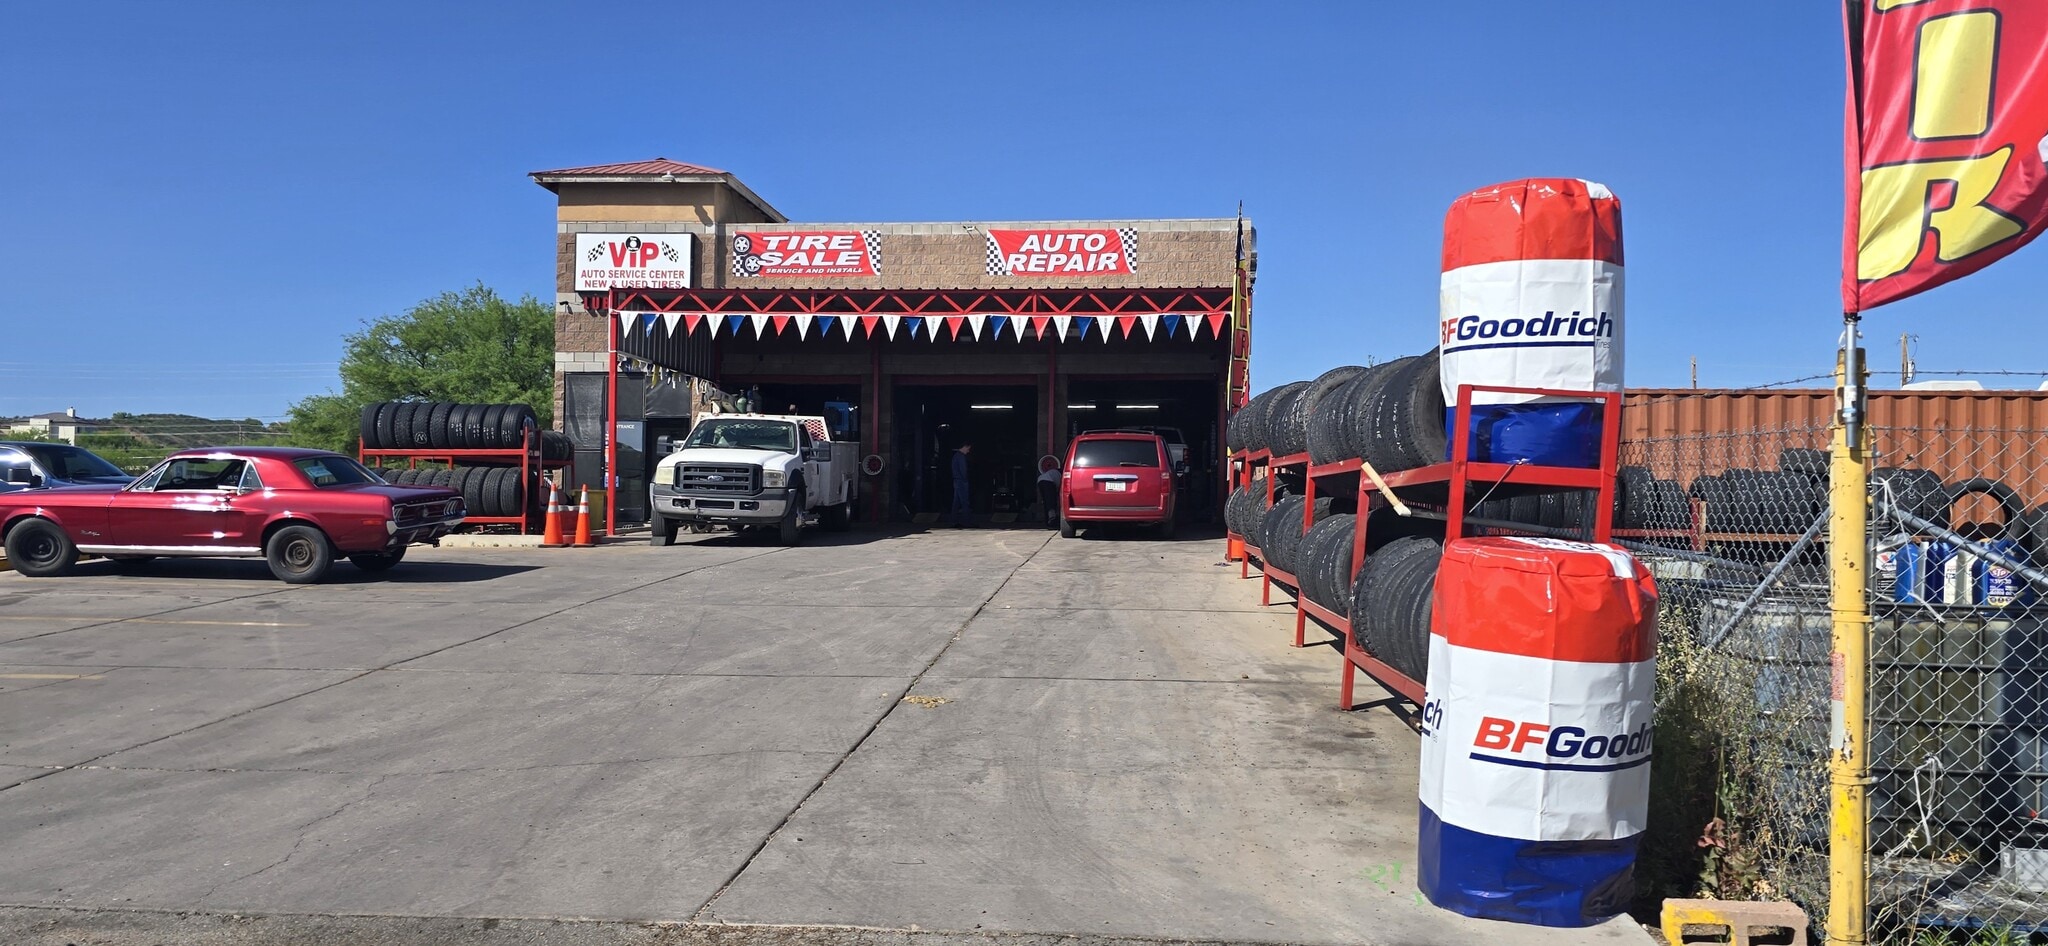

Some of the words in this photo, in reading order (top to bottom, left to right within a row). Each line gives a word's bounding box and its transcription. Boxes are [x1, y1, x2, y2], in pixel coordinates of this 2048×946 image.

[762, 235, 857, 250] TIRE
[1018, 233, 1107, 252] AUTO
[757, 250, 864, 266] SALE
[1005, 252, 1120, 272] REPAIR
[581, 270, 606, 278] AUTO
[608, 270, 647, 279] SERVICE
[649, 270, 685, 279] CENTER
[584, 280, 607, 288] NEW
[611, 280, 617, 288] &
[621, 280, 649, 288] USED
